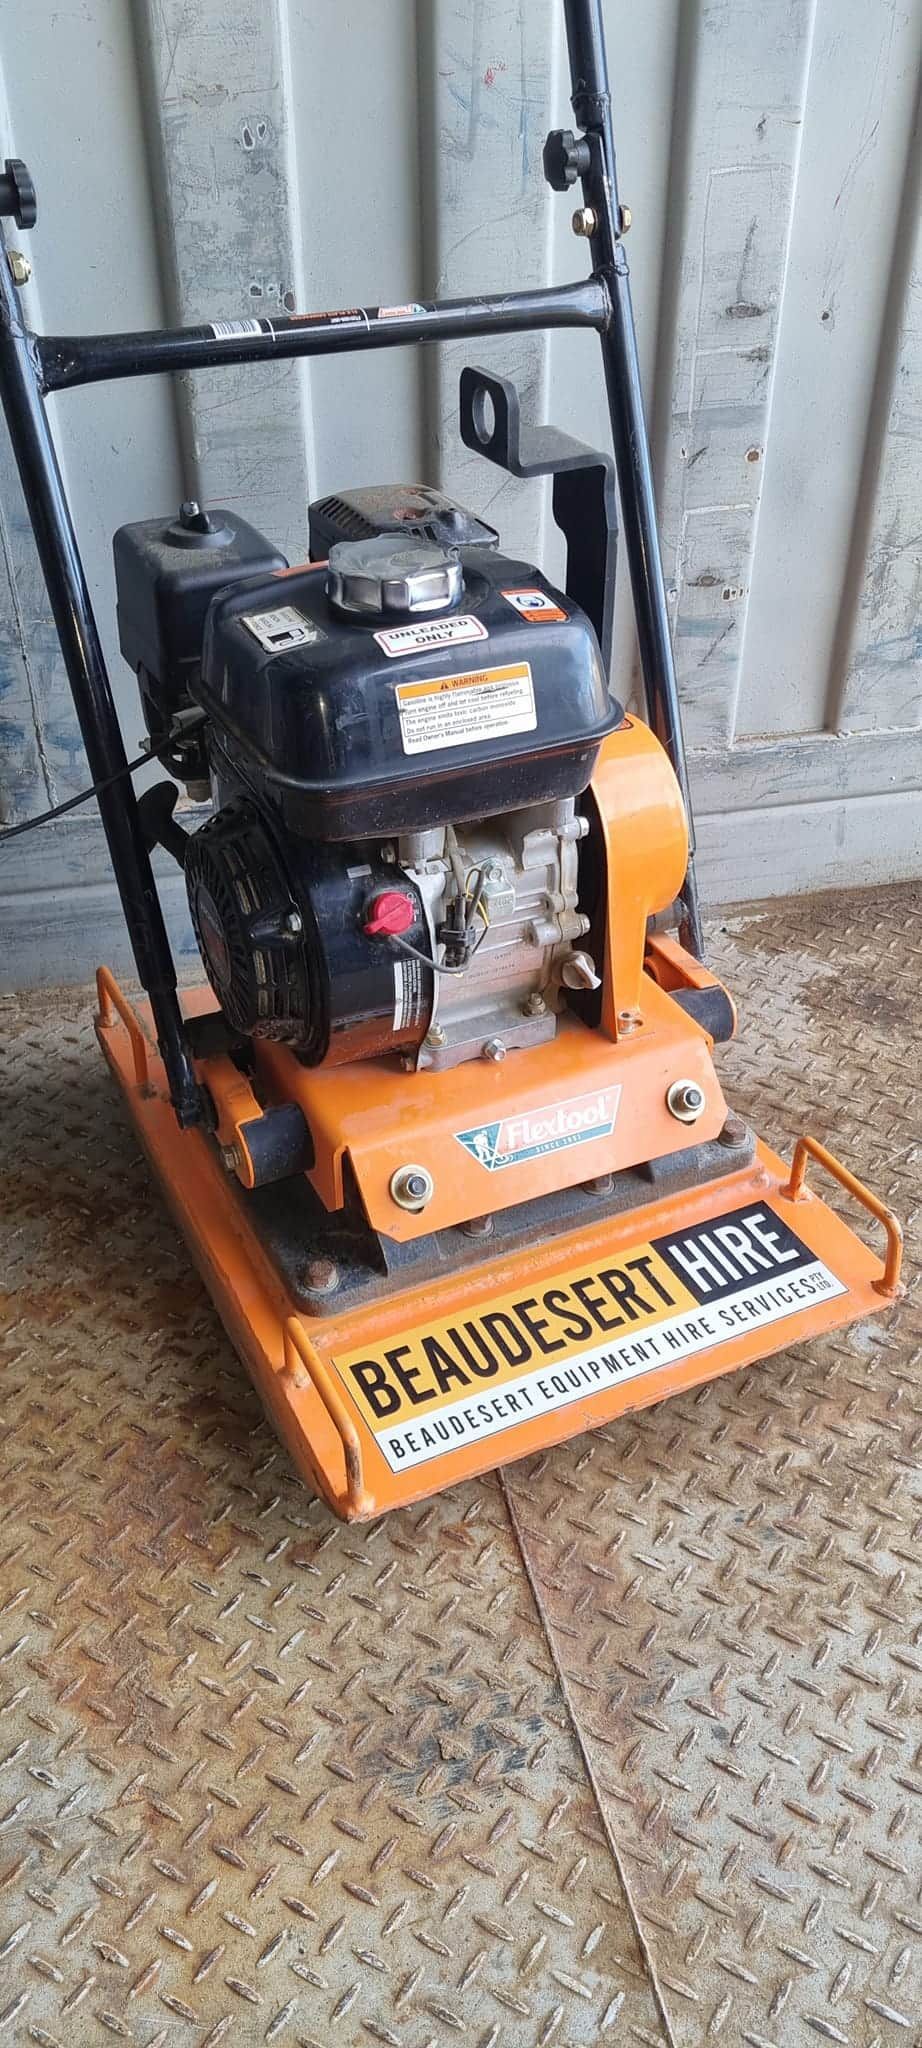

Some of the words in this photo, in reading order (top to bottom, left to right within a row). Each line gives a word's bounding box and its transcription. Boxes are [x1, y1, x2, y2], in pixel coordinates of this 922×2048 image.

[389, 620, 468, 640] UNLEADED
[415, 630, 455, 644] ONLY
[451, 674, 489, 688] WARNING
[407, 735, 423, 744] Read
[445, 727, 465, 737] Manual
[505, 1095, 611, 1150] Flextool
[808, 1271, 825, 1283] PTY
[349, 1256, 676, 1419] BEAUDESERT
[668, 1213, 800, 1293] HIRE
[388, 1387, 535, 1459] BEAUDESERT
[536, 1337, 661, 1400] EQUIPMENT
[661, 1316, 716, 1350] HIRE
[717, 1277, 817, 1327] SERVICES
